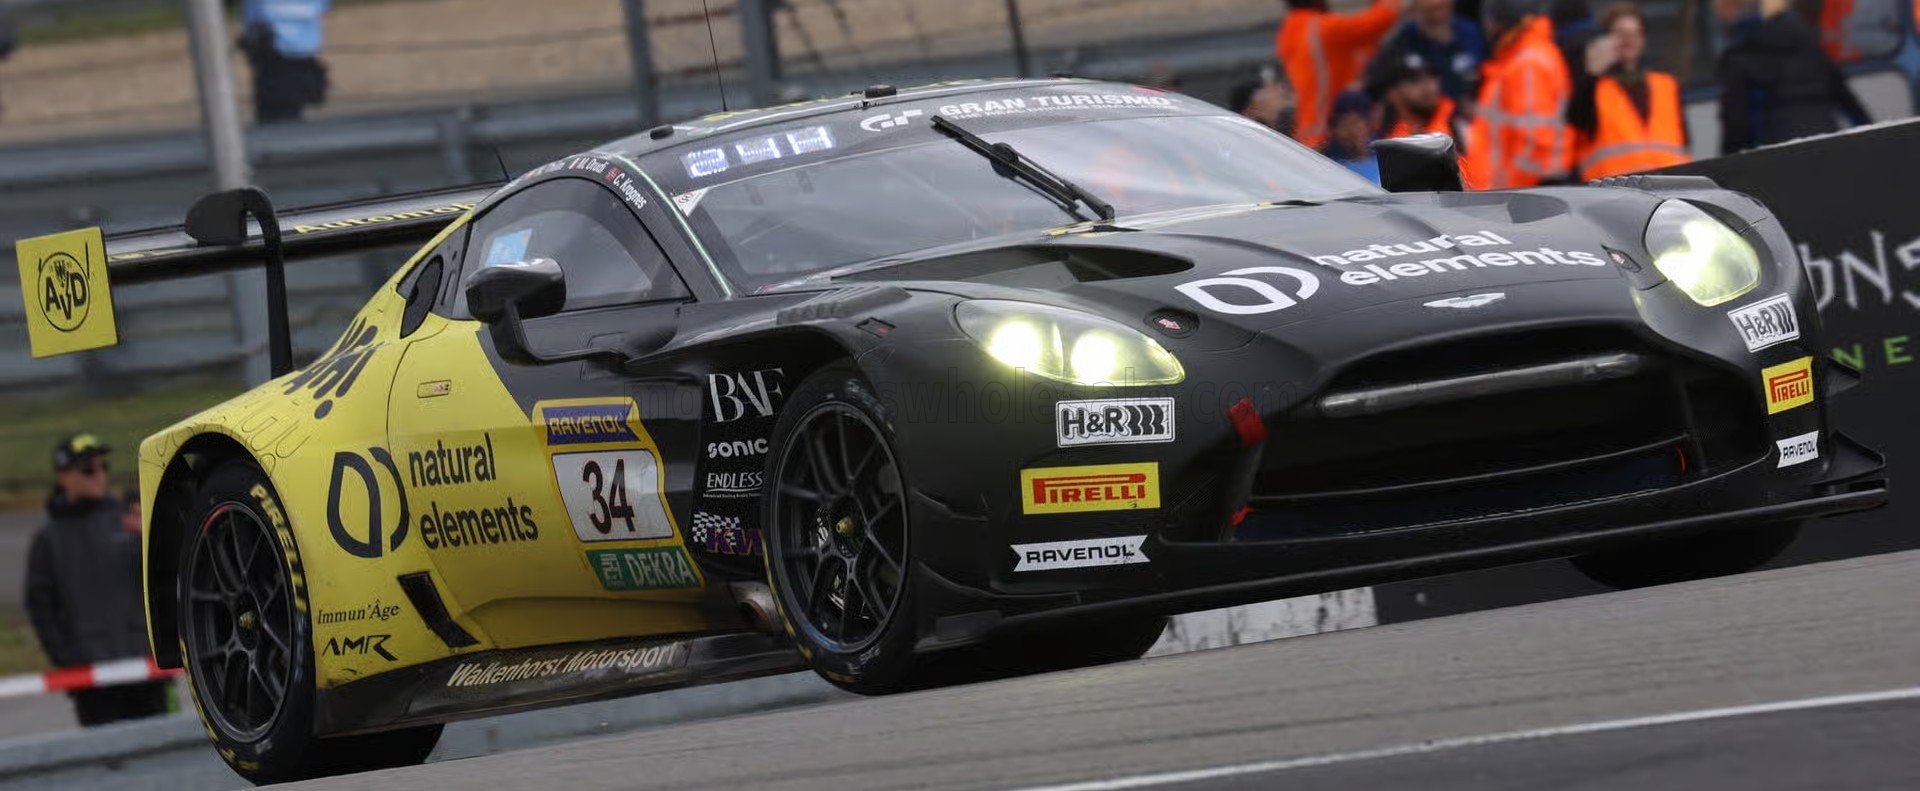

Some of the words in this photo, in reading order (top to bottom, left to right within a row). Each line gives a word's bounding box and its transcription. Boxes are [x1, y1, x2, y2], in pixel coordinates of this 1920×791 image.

[939, 96, 1026, 116] GRAN
[1031, 93, 1172, 107] TURISMO
[619, 177, 648, 210] Krognes
[1310, 230, 1513, 266] natural
[1340, 246, 1606, 286] elements
[1735, 308, 1779, 342] H&R
[1768, 368, 1811, 404] PIRELLI
[549, 414, 627, 436] RAVENOL
[1062, 406, 1129, 439] H&R
[408, 432, 497, 488] natural
[1783, 440, 1816, 460] RAVENOL
[582, 458, 636, 535] 34
[707, 471, 764, 489] ENDLESS
[1032, 473, 1147, 504] PIRELLI
[419, 497, 539, 550] elements
[250, 484, 307, 613] PIRELLI
[1026, 544, 1136, 564] RAVENOL
[623, 549, 697, 587] DEKRA
[322, 634, 399, 662] AMR
[446, 653, 568, 688] Walkenhorst
[562, 641, 683, 674] Motorsport
